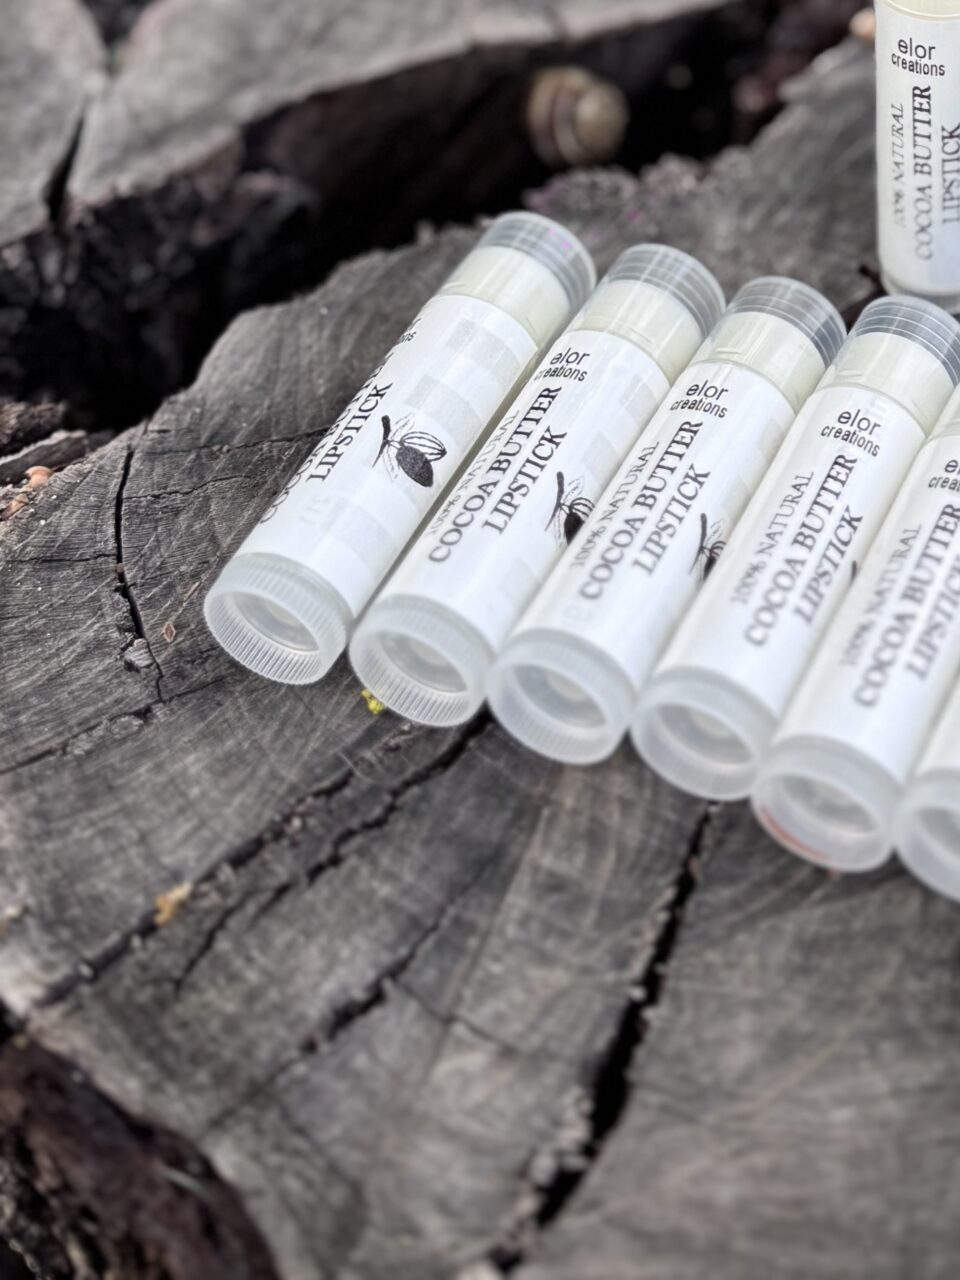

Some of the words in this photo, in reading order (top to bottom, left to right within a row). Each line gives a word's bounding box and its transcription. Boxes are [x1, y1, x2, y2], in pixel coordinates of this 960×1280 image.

[891, 53, 945, 76] creations
[898, 37, 935, 60] elor
[912, 85, 932, 176] BUTTER
[941, 123, 960, 224] LIPSTICK
[914, 184, 933, 260] COCOA
[534, 364, 588, 382] creations
[550, 347, 590, 367] elor
[686, 380, 728, 401] elor
[305, 383, 394, 482] LIPSTICK
[670, 397, 728, 418] creations
[820, 424, 880, 457] creations
[837, 409, 881, 436] elor
[428, 479, 500, 563] COCOA
[487, 386, 562, 476] BUTTER
[482, 425, 568, 535] LIPSTICK
[579, 516, 647, 600] COCOA
[632, 420, 704, 511] BUTTER
[756, 471, 814, 556] NATURAL
[632, 463, 711, 576] LIPSTICK
[744, 557, 807, 648] COCOA
[791, 454, 858, 553] BUTTER
[793, 505, 864, 625] LIPSTICK
[853, 612, 917, 709] COCOA
